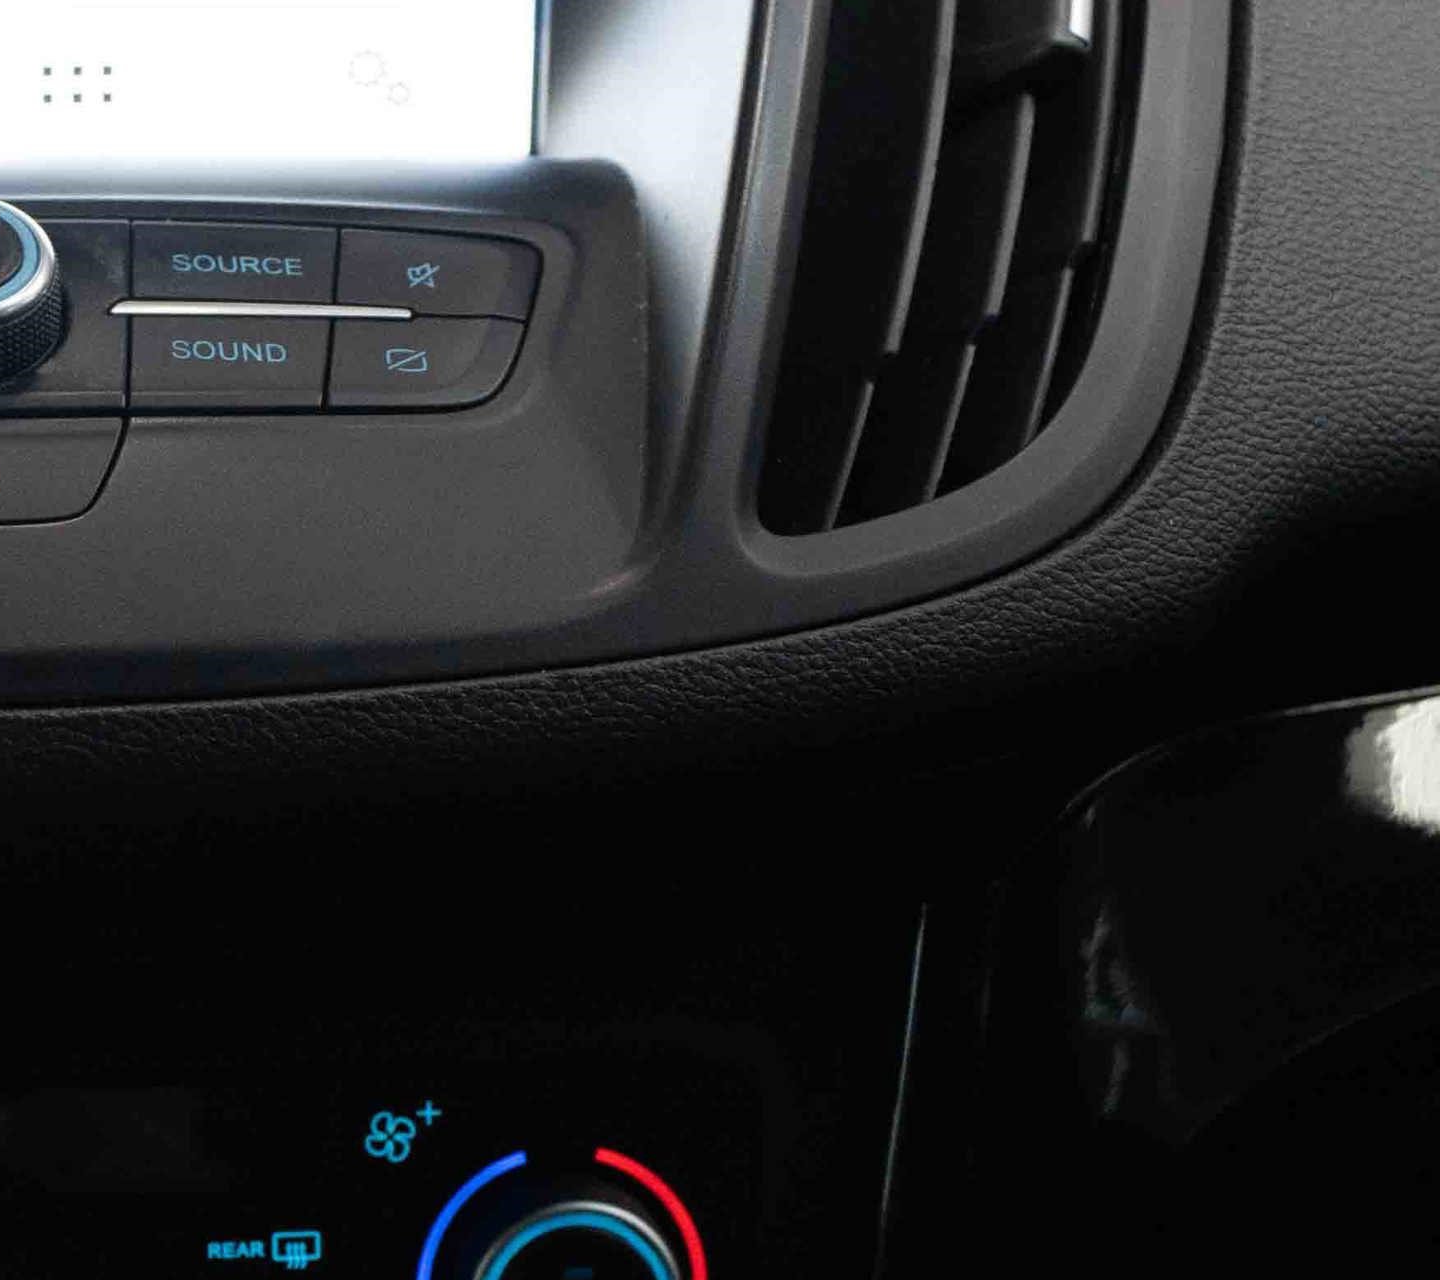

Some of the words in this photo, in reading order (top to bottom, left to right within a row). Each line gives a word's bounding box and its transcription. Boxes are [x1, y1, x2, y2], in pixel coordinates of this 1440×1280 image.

[171, 253, 303, 276] SOURCE
[171, 339, 287, 363] SOUND
[207, 1240, 265, 1260] REAR
